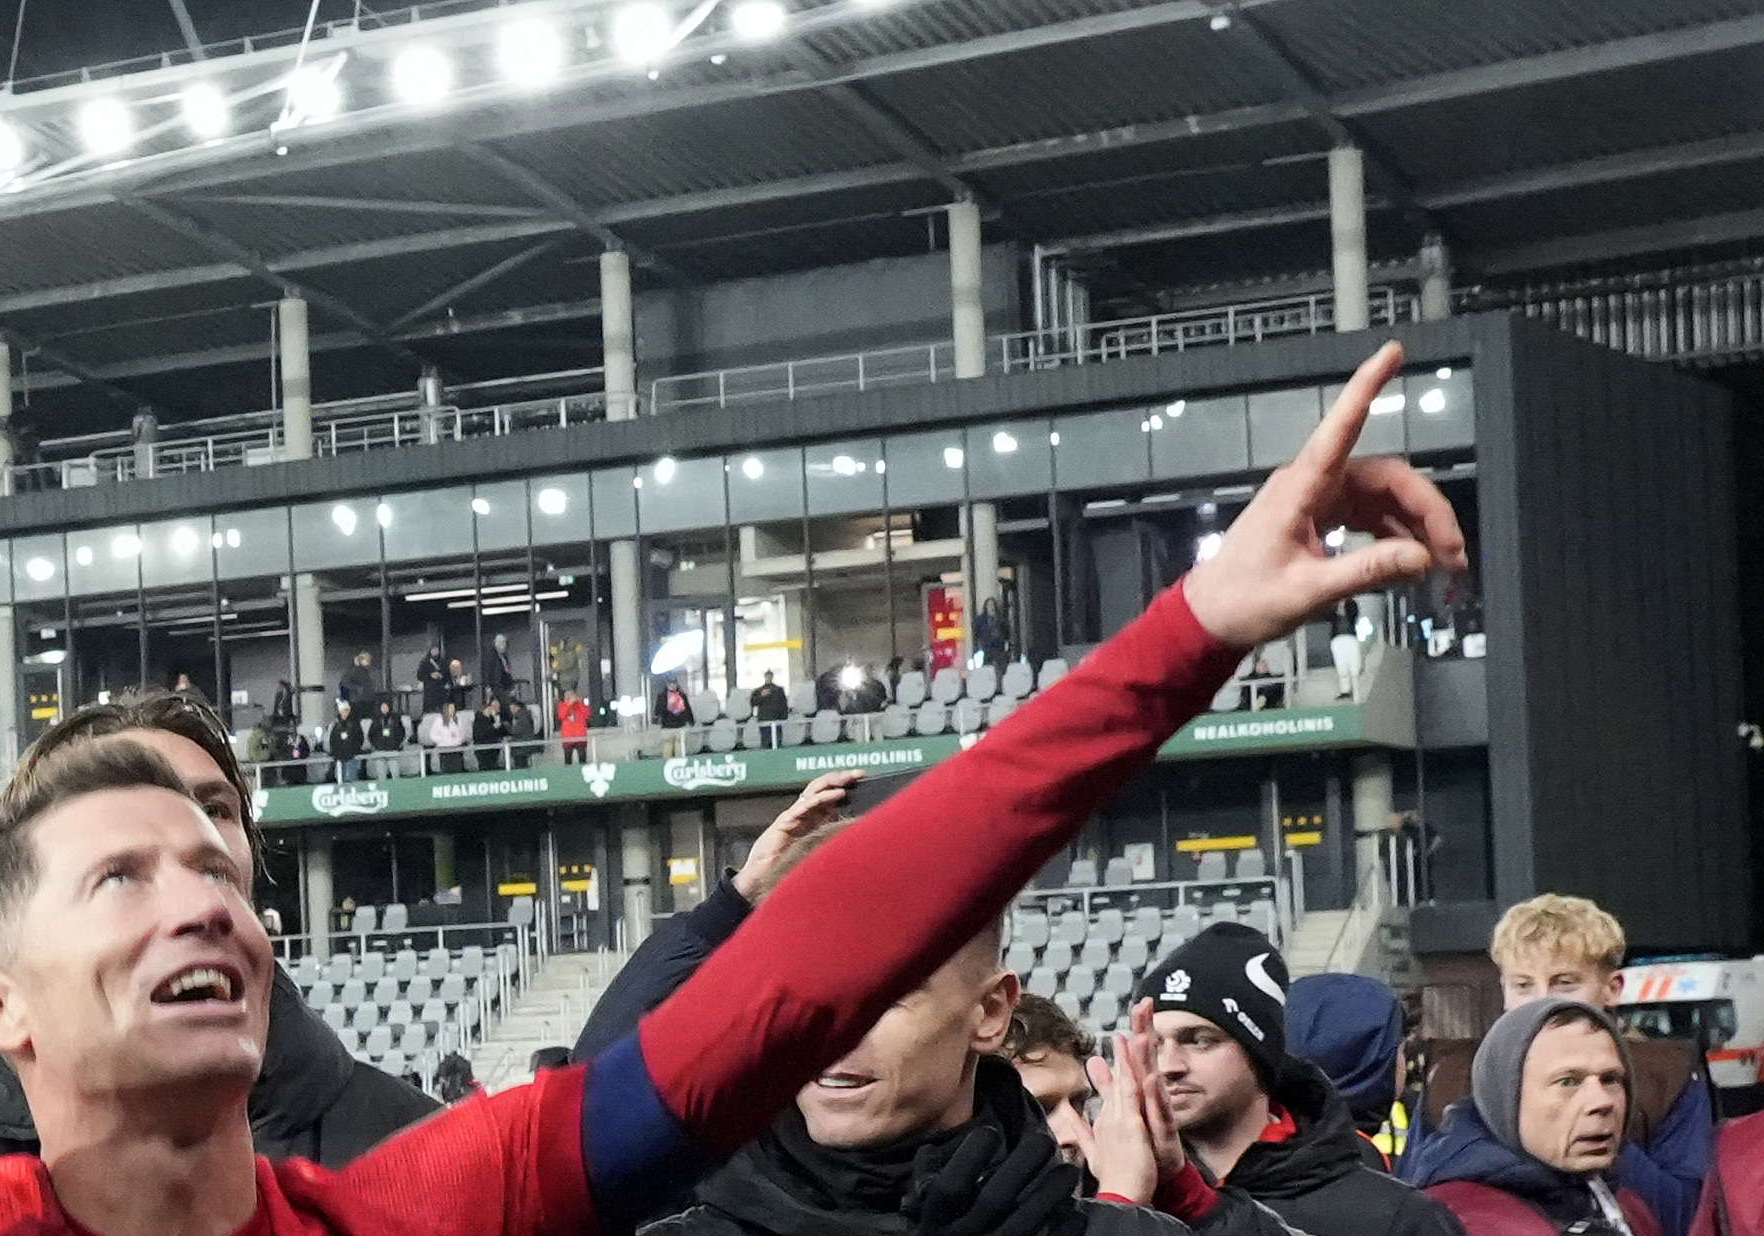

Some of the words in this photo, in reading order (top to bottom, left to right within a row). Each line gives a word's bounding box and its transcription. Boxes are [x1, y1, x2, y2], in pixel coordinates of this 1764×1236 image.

[1194, 716, 1334, 740] NEALKOHOLINIS
[663, 754, 747, 790] Carlsberg
[796, 748, 923, 771] NEALKOHOLINIS
[311, 781, 389, 817] Carlsberg
[432, 777, 549, 799] NEALKOHOLINIS
